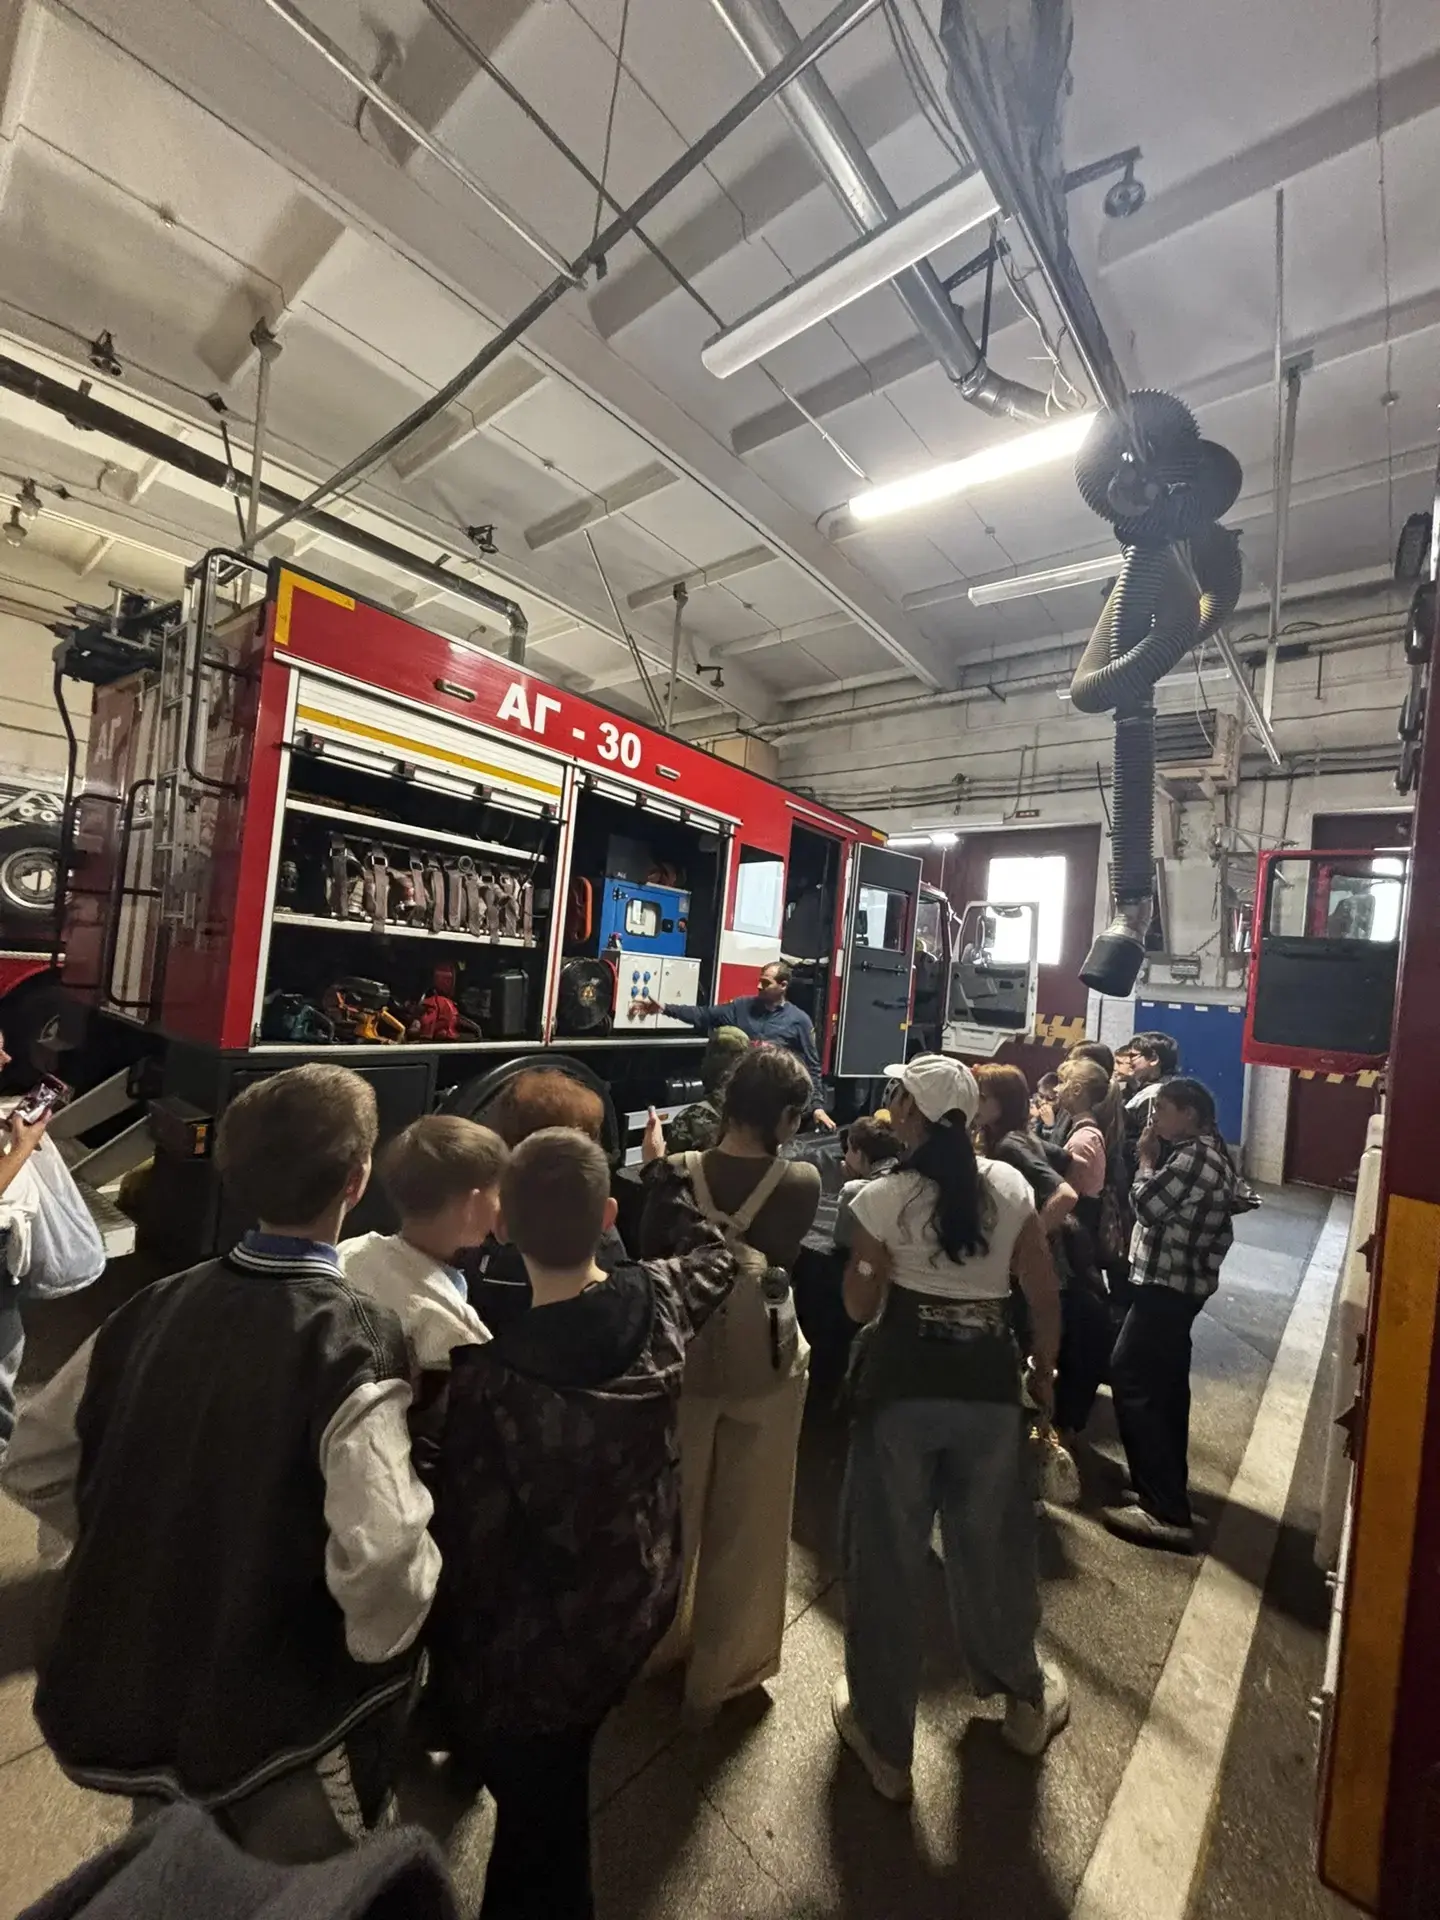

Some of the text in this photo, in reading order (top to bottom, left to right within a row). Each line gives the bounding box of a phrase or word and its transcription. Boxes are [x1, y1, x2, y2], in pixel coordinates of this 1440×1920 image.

[496, 682, 642, 769] АГ - 30
